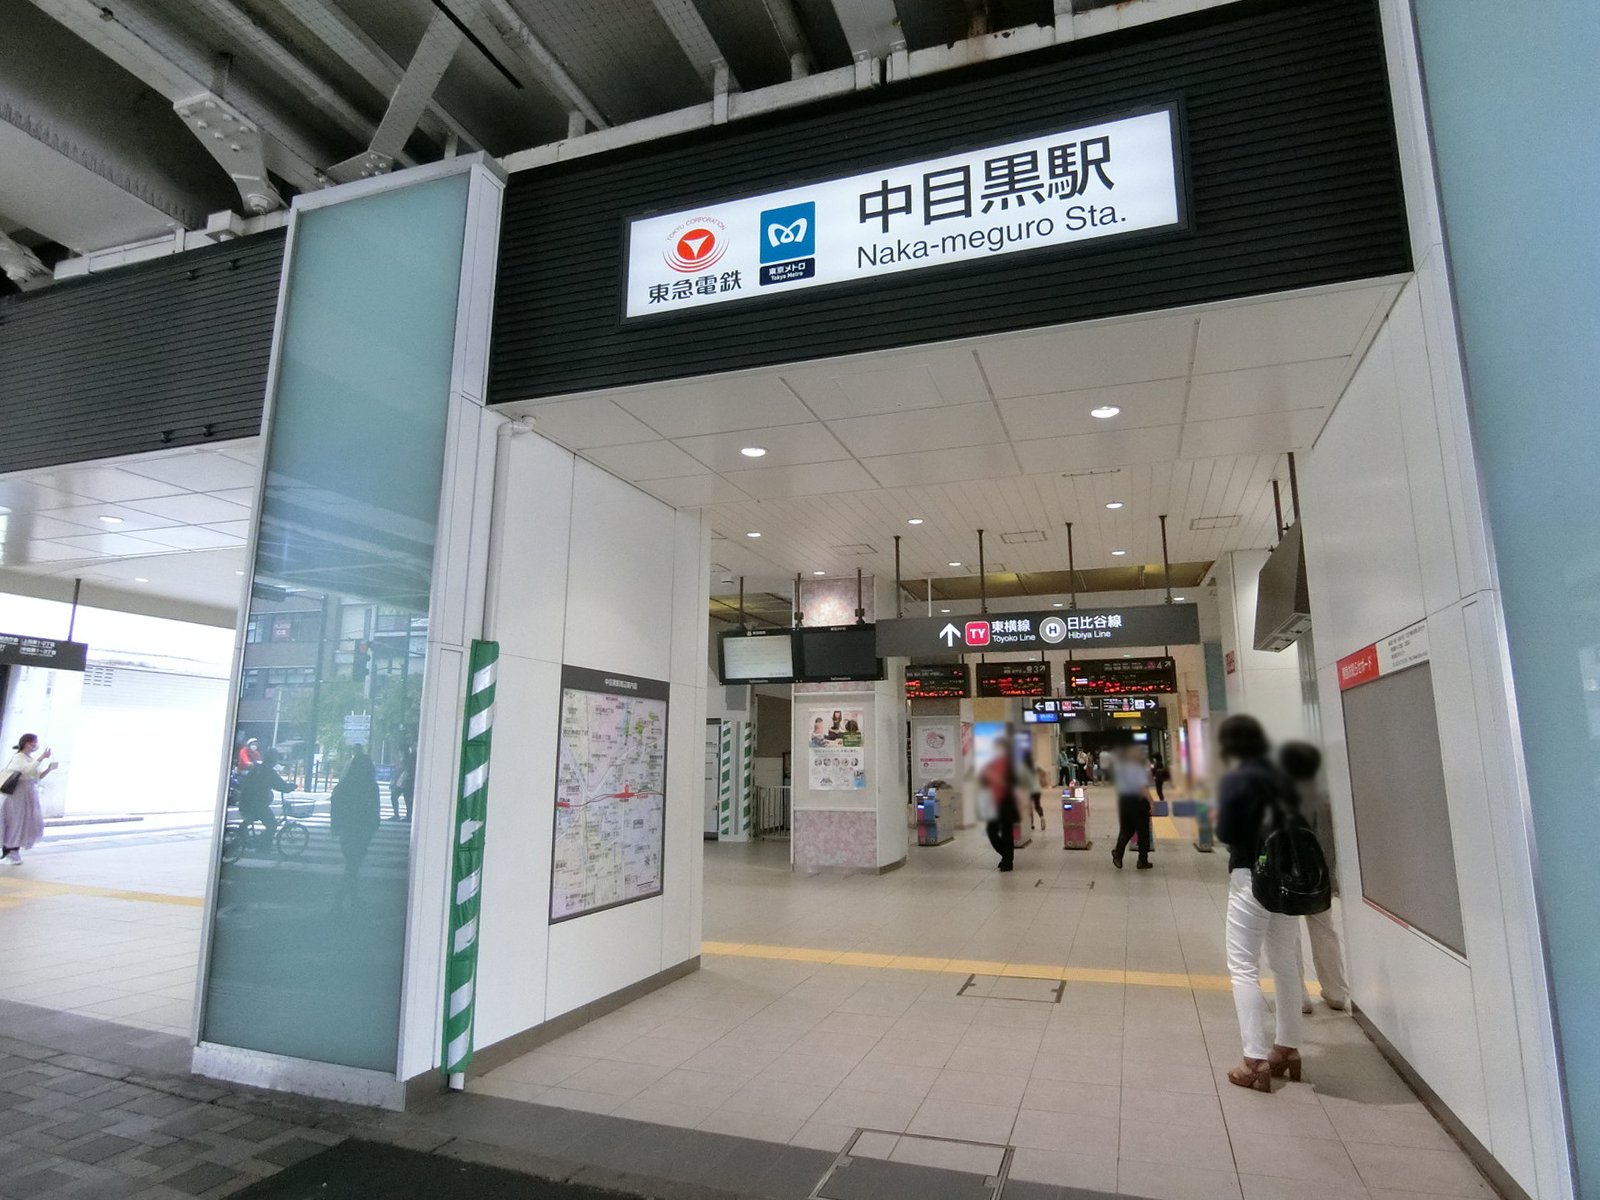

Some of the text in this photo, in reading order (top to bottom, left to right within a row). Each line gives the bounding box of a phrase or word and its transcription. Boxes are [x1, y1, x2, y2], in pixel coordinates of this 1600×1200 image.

[859, 136, 1115, 234] 中目黒駅
[667, 216, 727, 241] TOKYU CORPORATION
[858, 204, 1127, 268] Naka-meguro Sta.
[768, 262, 806, 276] 東京メトロ
[648, 270, 742, 304] 東急電鉄
[991, 619, 1032, 633] 東横線
[1067, 614, 1123, 630] 日比谷線
[969, 628, 986, 639] TY
[1048, 626, 1058, 635] H
[1068, 630, 1112, 640] Hibiya Line
[992, 633, 1036, 644] Toyoko Line
